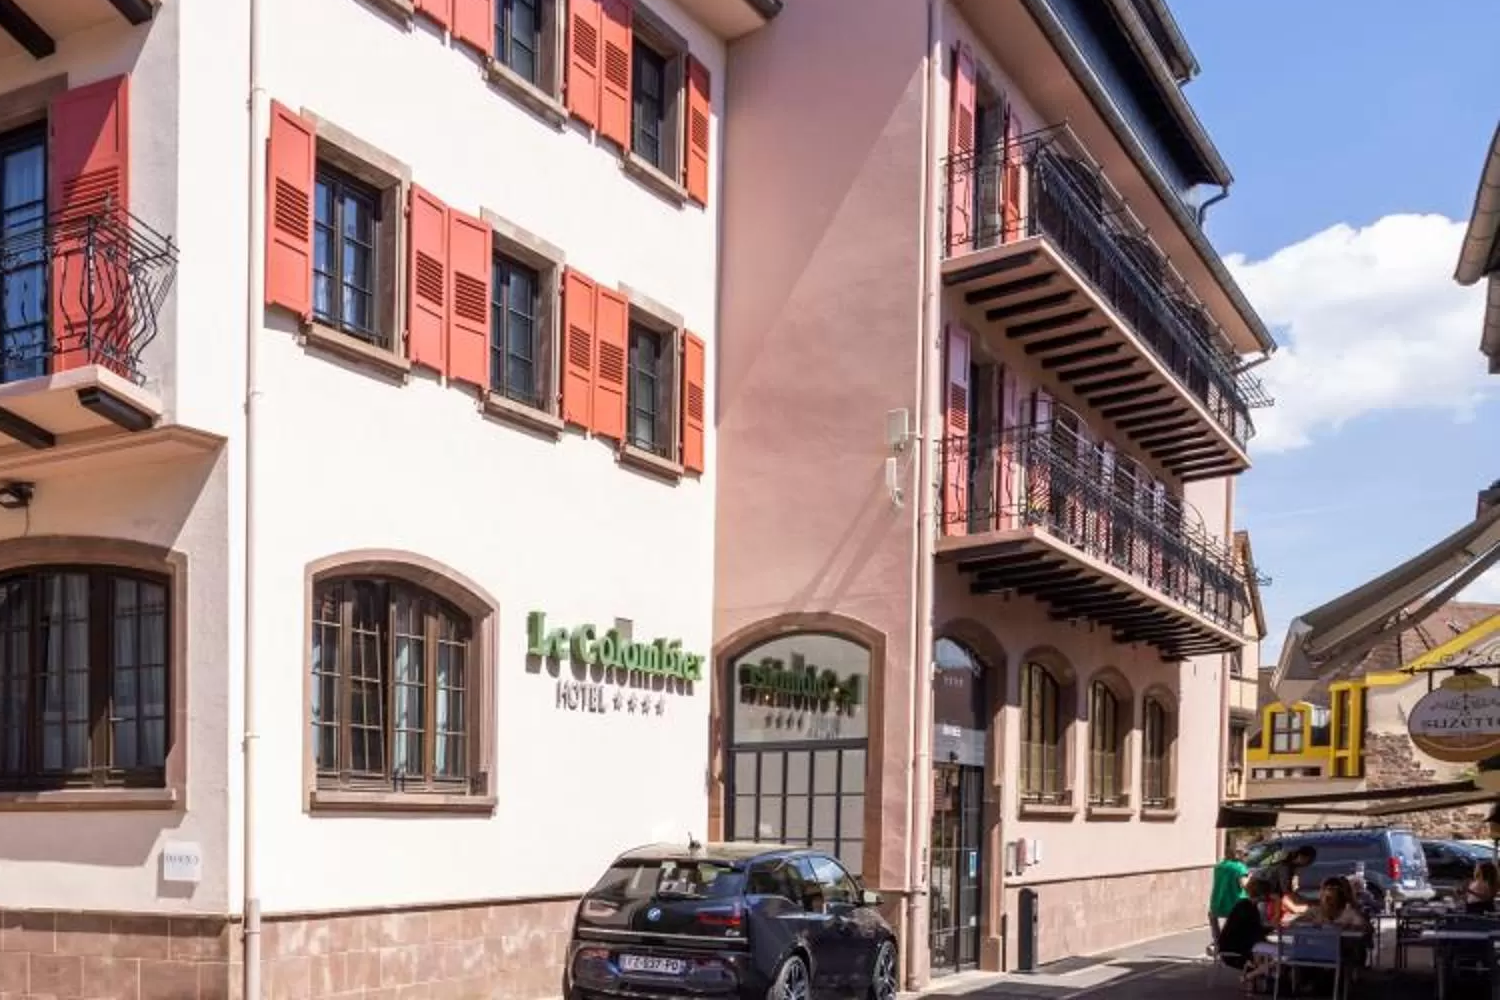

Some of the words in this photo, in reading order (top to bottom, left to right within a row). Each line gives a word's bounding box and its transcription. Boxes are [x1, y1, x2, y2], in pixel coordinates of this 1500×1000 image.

[527, 611, 569, 660] Le
[570, 623, 705, 681] Colombier
[555, 680, 606, 714] HOTEL
